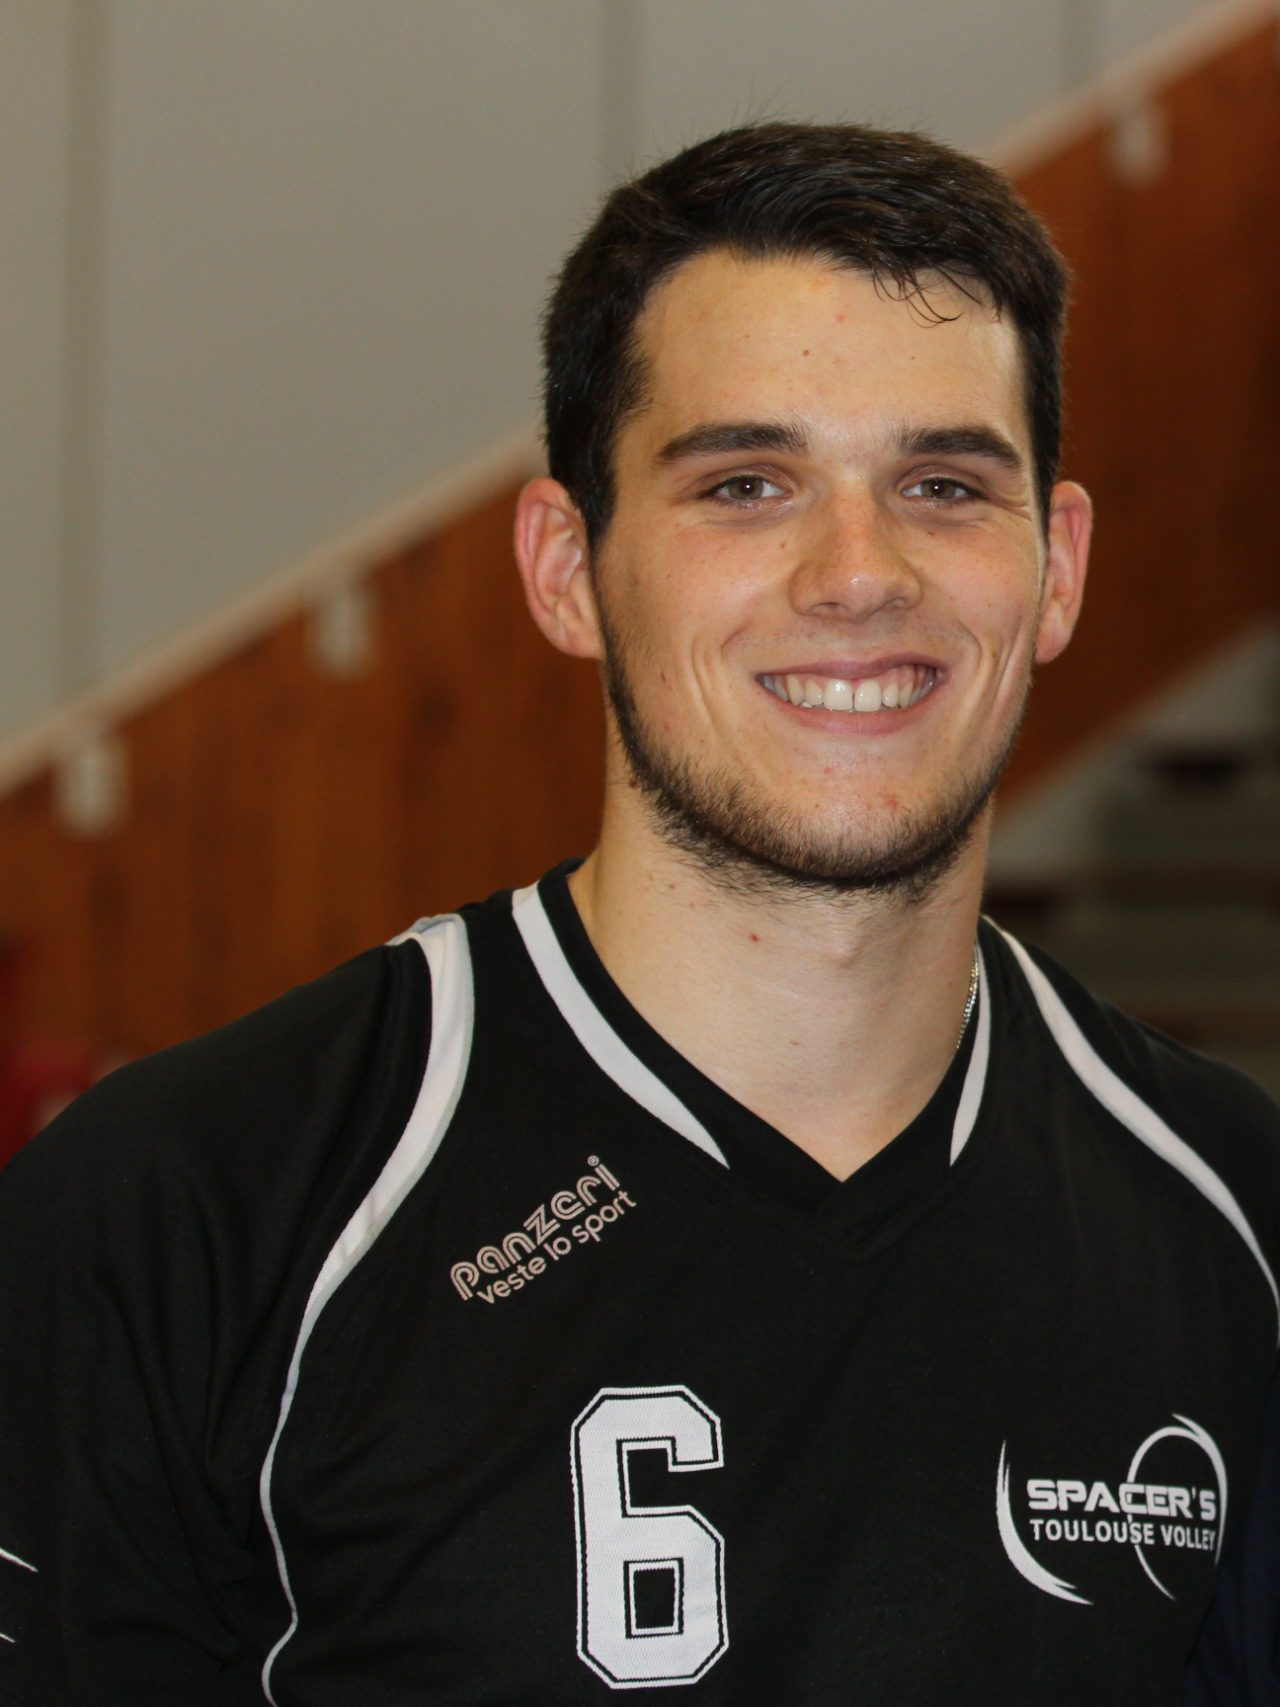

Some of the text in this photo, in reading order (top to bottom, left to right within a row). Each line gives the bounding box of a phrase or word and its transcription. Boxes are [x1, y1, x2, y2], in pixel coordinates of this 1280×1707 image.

[450, 1155, 620, 1300] panzeri
[476, 1190, 636, 1304] veste lo sport
[570, 1385, 729, 1689] 6
[1027, 1479, 1216, 1521] SPACER'S
[1029, 1519, 1216, 1550] TOULOUSE VOLLEY
